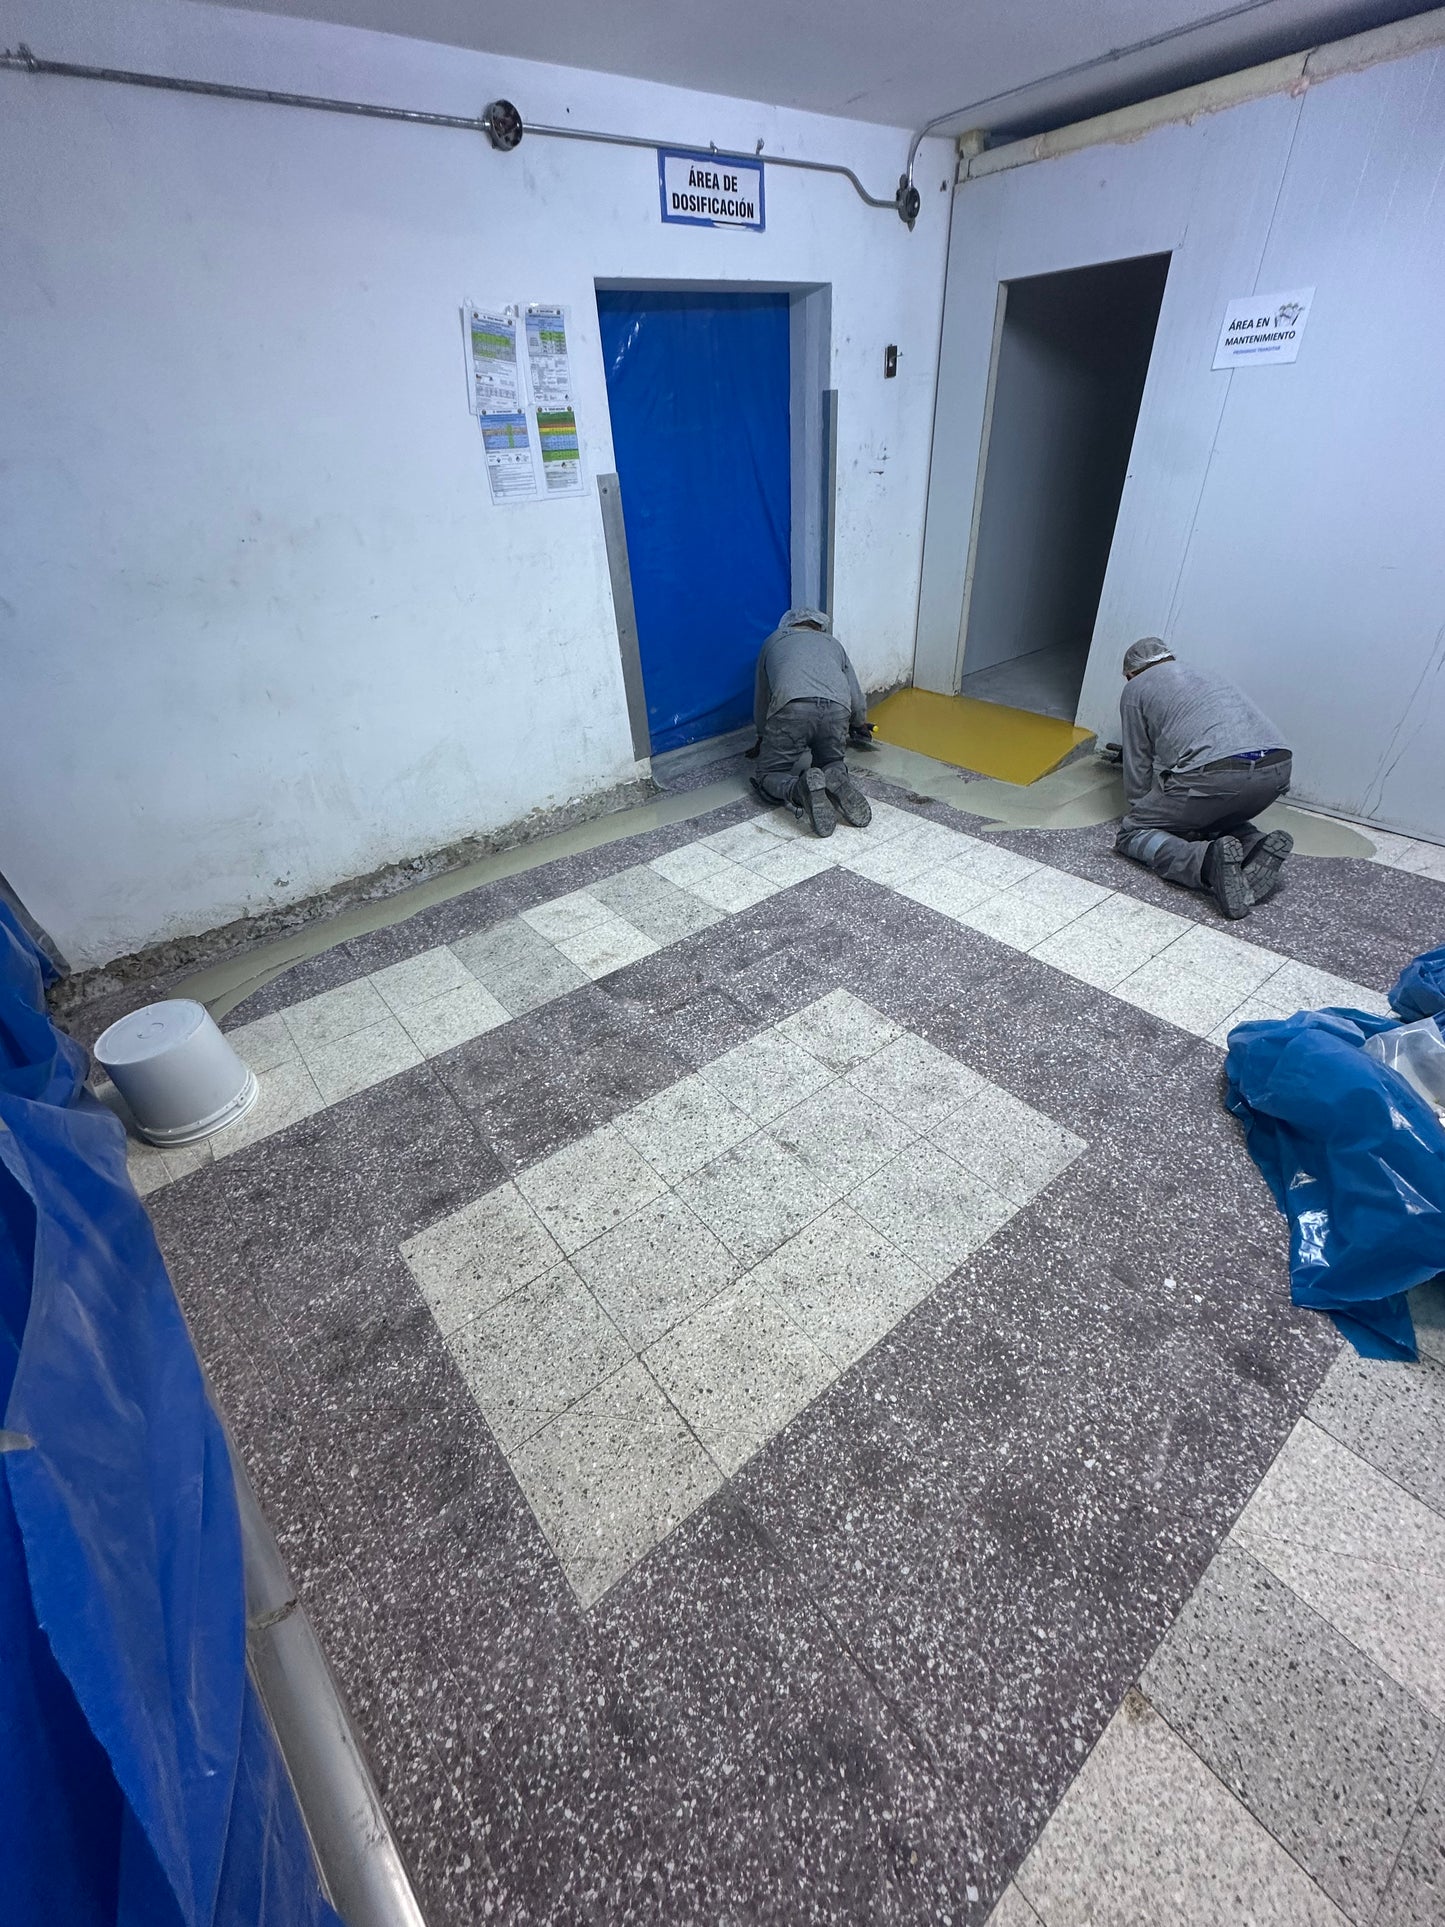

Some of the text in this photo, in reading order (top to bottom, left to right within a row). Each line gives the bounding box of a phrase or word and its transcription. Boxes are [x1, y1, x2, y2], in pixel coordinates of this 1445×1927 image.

[689, 165, 738, 192] ÁREA DE
[672, 193, 754, 219] DOSIFICACIÓN
[1228, 317, 1270, 331] ÁREA EN
[1225, 330, 1296, 346] MANTENIMIENTO
